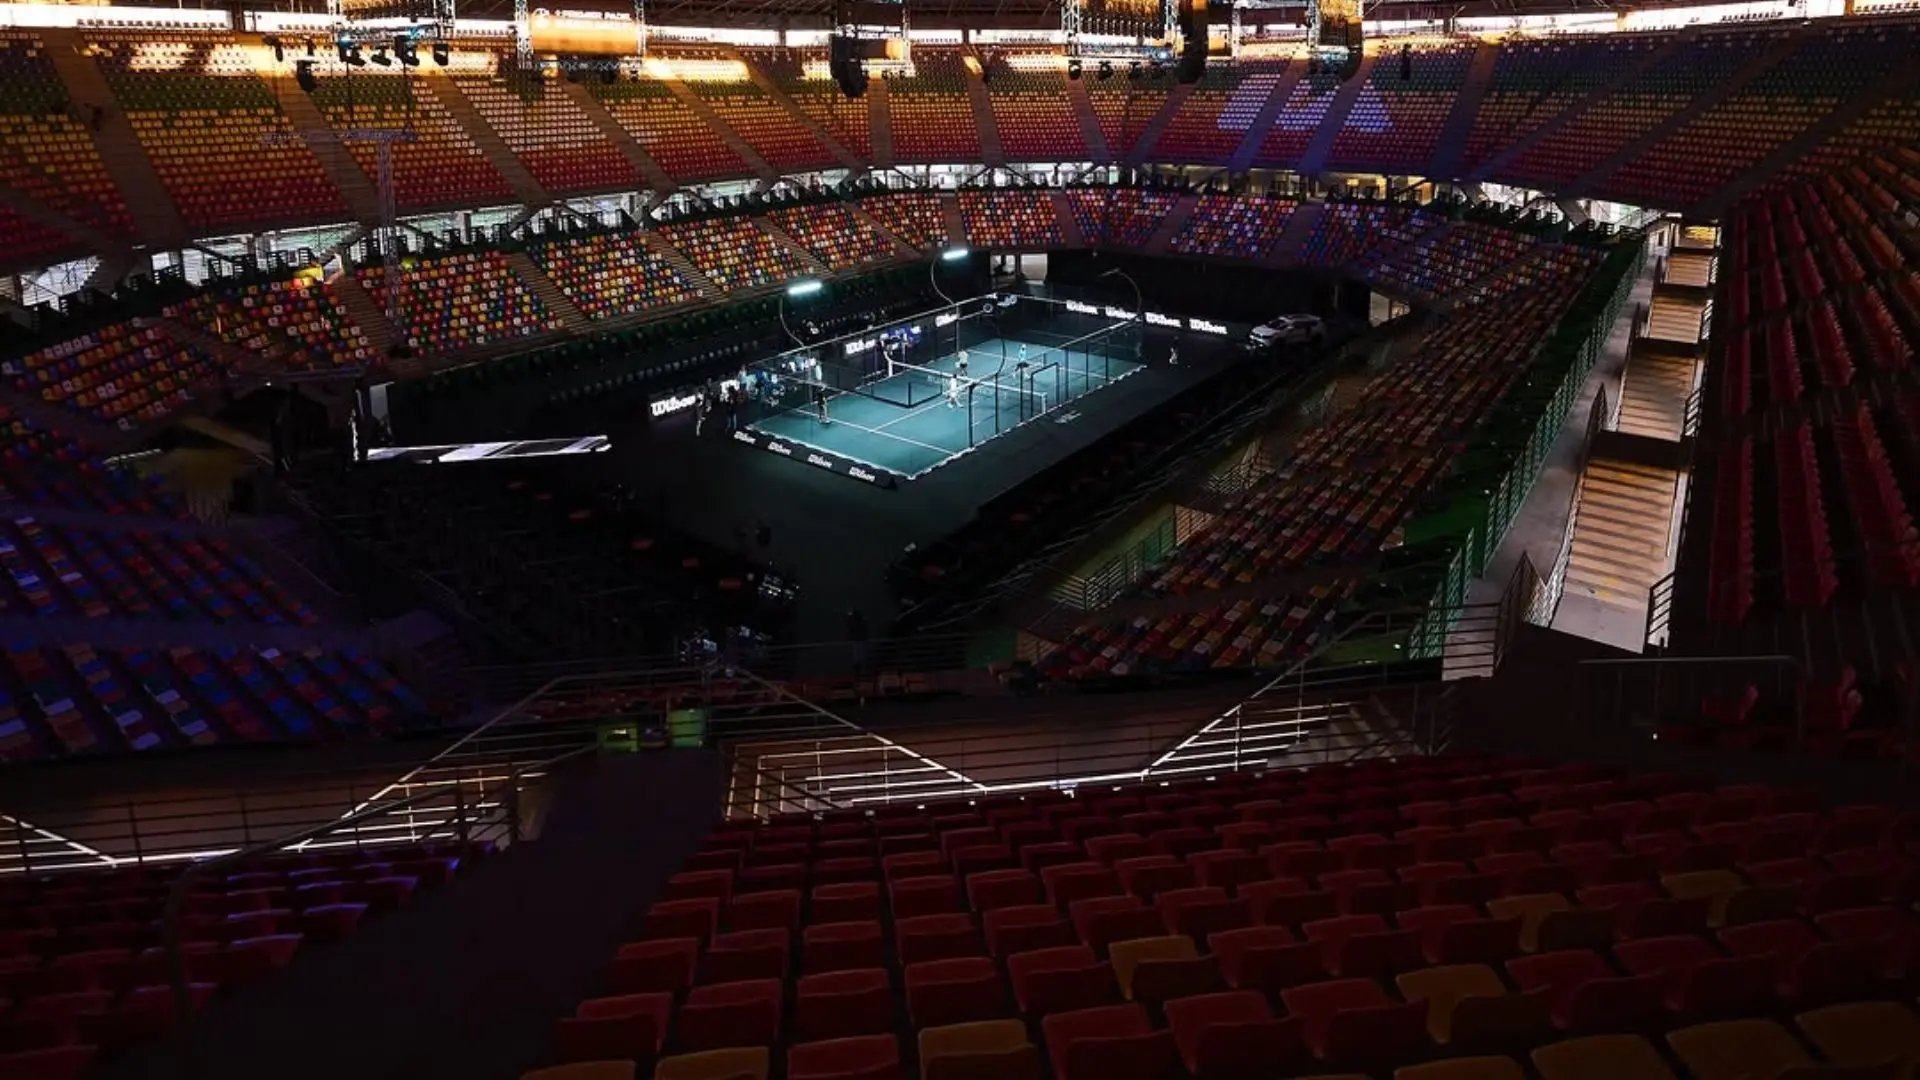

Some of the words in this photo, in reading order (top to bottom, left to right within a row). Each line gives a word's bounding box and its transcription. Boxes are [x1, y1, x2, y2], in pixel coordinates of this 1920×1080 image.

[1145, 311, 1182, 328] Wilson
[1189, 318, 1228, 335] Wilson
[651, 395, 697, 416] Wilson
